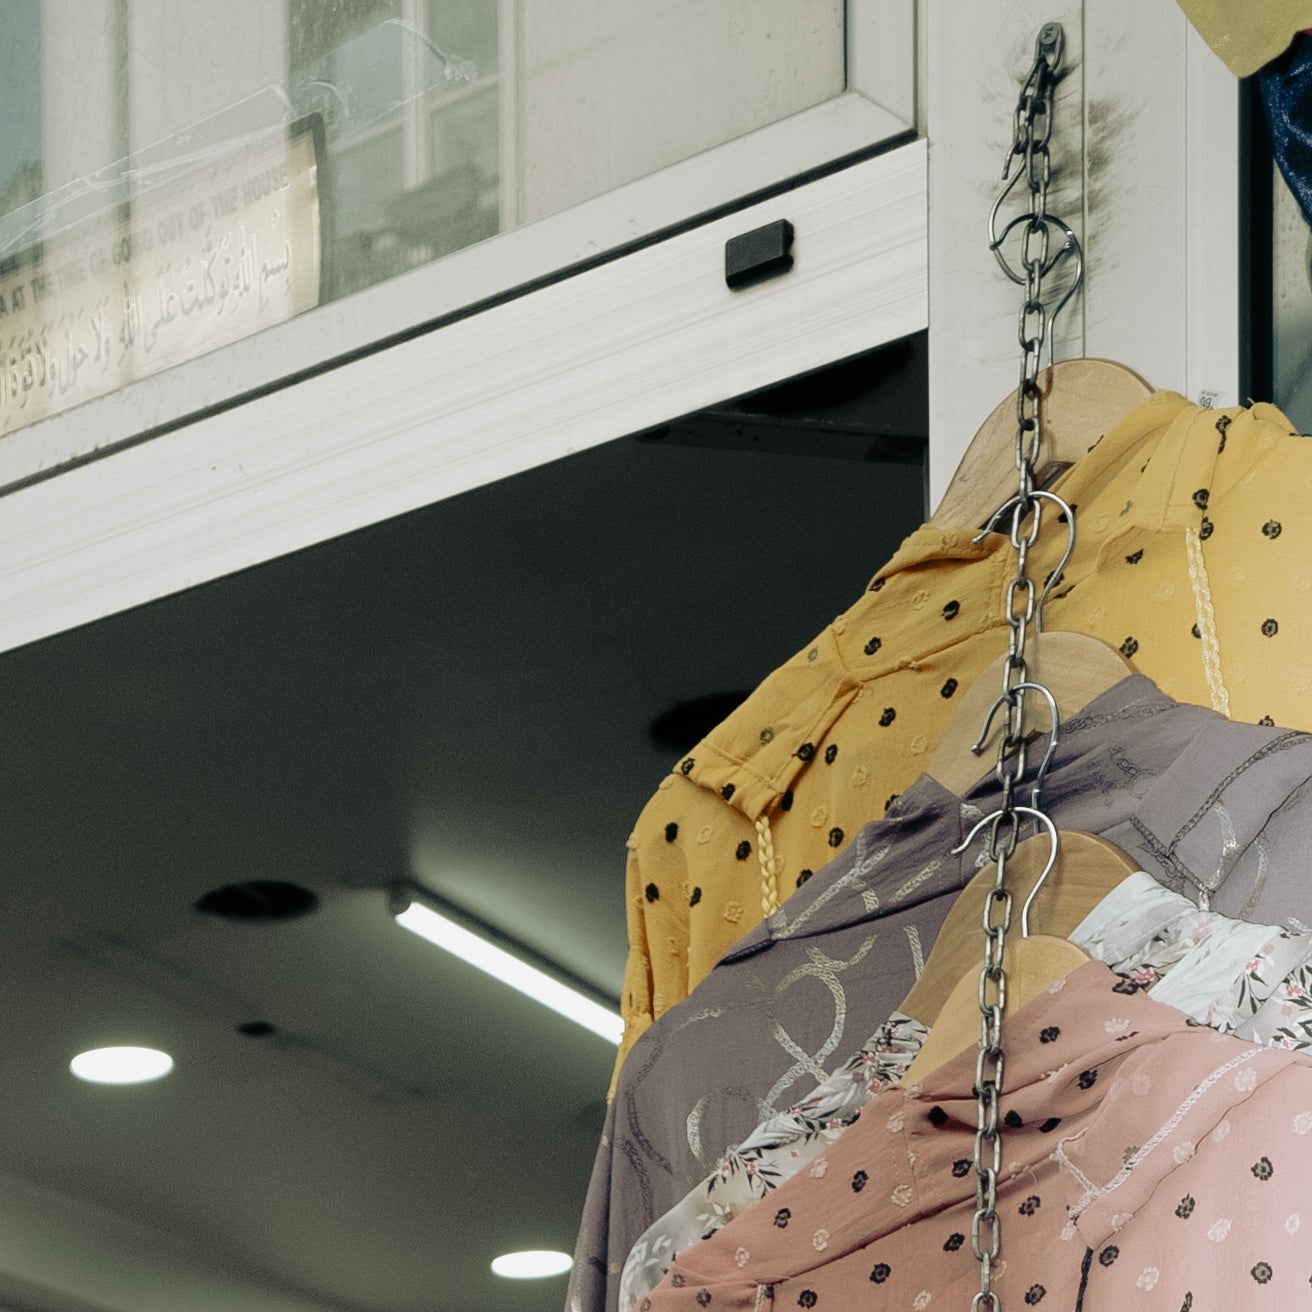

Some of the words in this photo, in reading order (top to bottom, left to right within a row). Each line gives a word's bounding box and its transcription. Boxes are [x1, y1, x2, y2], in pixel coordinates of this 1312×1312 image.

[11, 285, 26, 314] AT
[30, 270, 54, 301] THE
[157, 211, 183, 246] OUT
[188, 201, 207, 231] OF
[212, 188, 239, 221] THE
[242, 166, 291, 205] HOUSE
